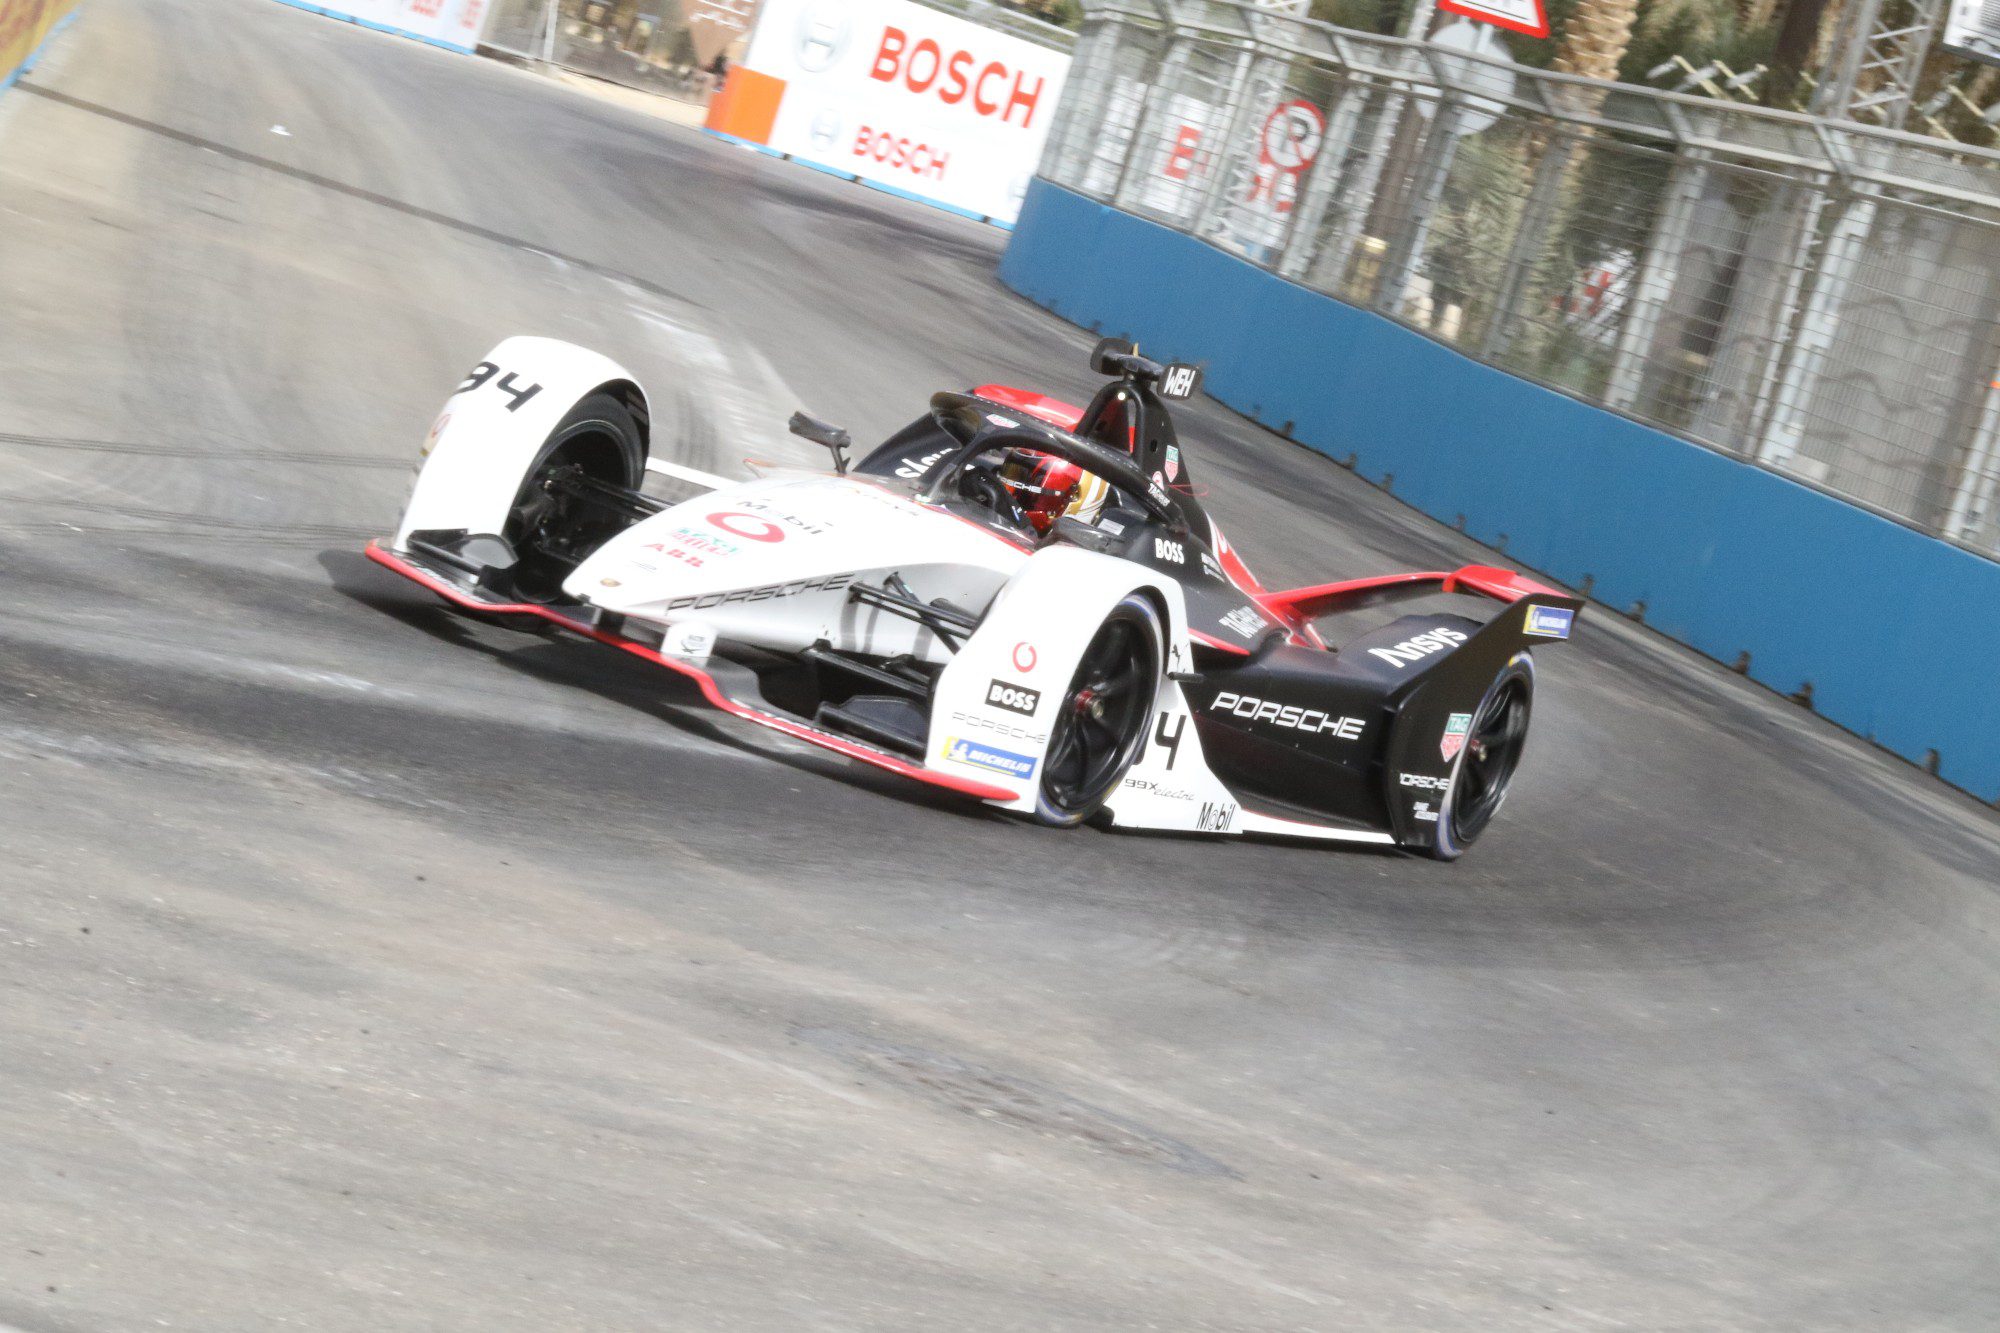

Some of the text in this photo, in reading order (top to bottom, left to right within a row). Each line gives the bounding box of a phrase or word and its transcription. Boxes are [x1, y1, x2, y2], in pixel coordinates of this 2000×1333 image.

[869, 25, 1045, 128] BOSCH
[853, 125, 951, 181] BOSCH
[1163, 366, 1196, 397] WEH
[1155, 537, 1185, 565] BOSS
[665, 573, 855, 617] PORSCHE
[1368, 627, 1468, 668] Ansys
[988, 684, 1036, 711] BOSS
[952, 711, 1047, 744] PORSCHE
[1209, 691, 1366, 741] PORSCHE
[967, 750, 1032, 773] MICHELIN
[1196, 801, 1236, 831] Mobil
